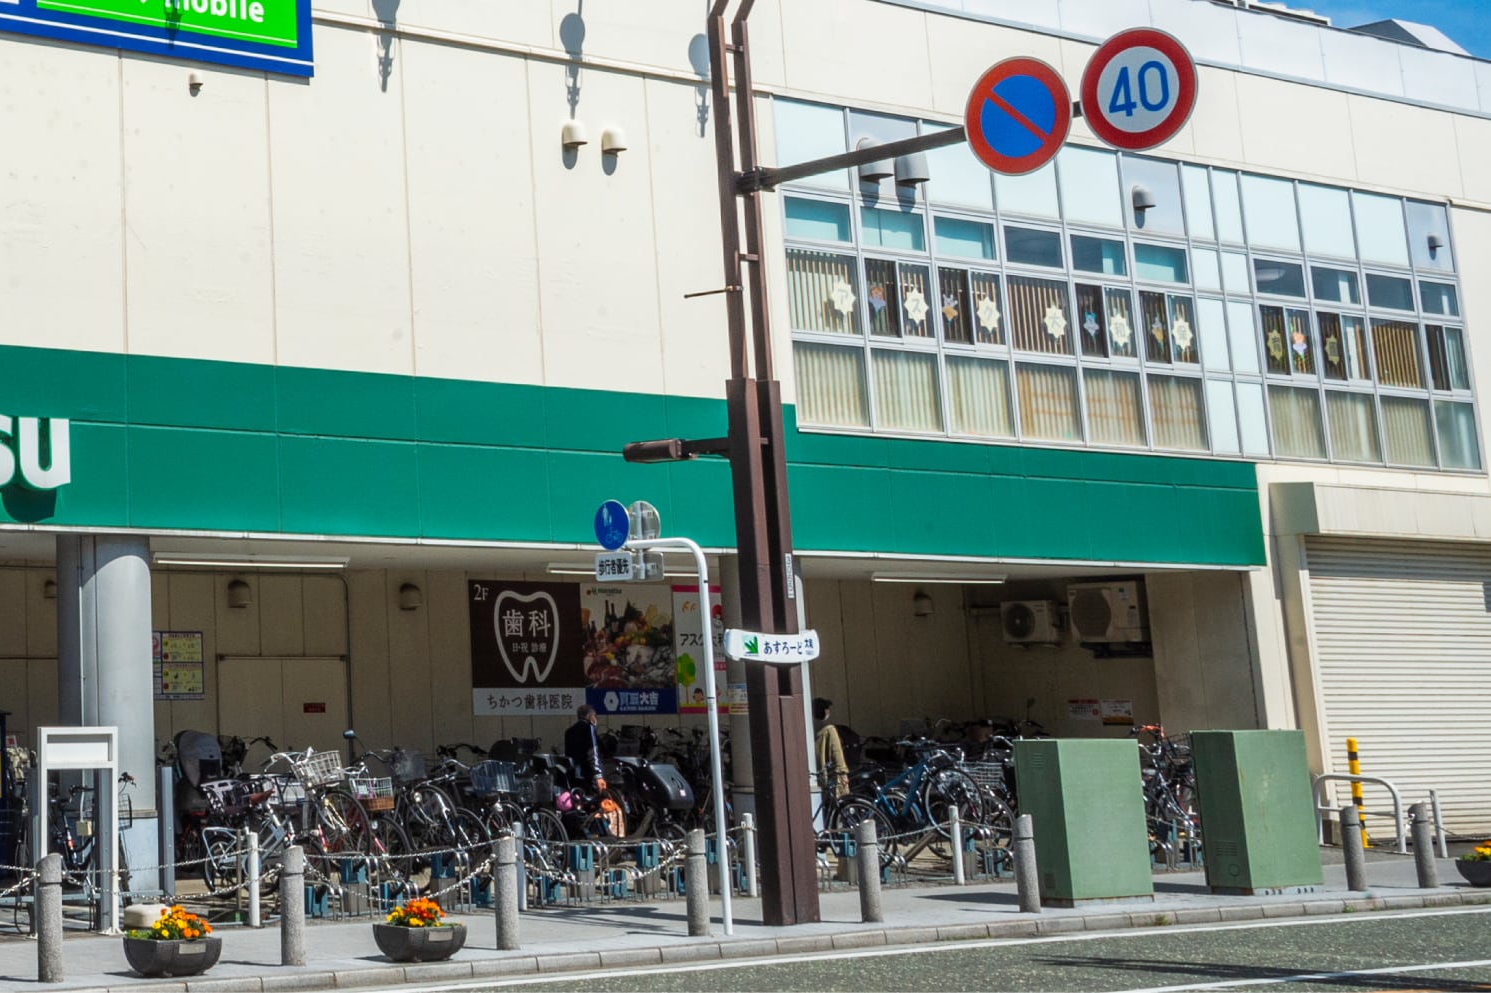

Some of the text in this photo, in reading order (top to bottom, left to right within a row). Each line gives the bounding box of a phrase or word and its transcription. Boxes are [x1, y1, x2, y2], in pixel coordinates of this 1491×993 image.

[1108, 59, 1171, 119] 40
[598, 558, 630, 576] 歩行者優先
[473, 584, 489, 601] 2F
[502, 609, 552, 638] 歯科
[763, 640, 803, 655] あすろーど
[487, 694, 574, 710] ちかつ歯科医院
